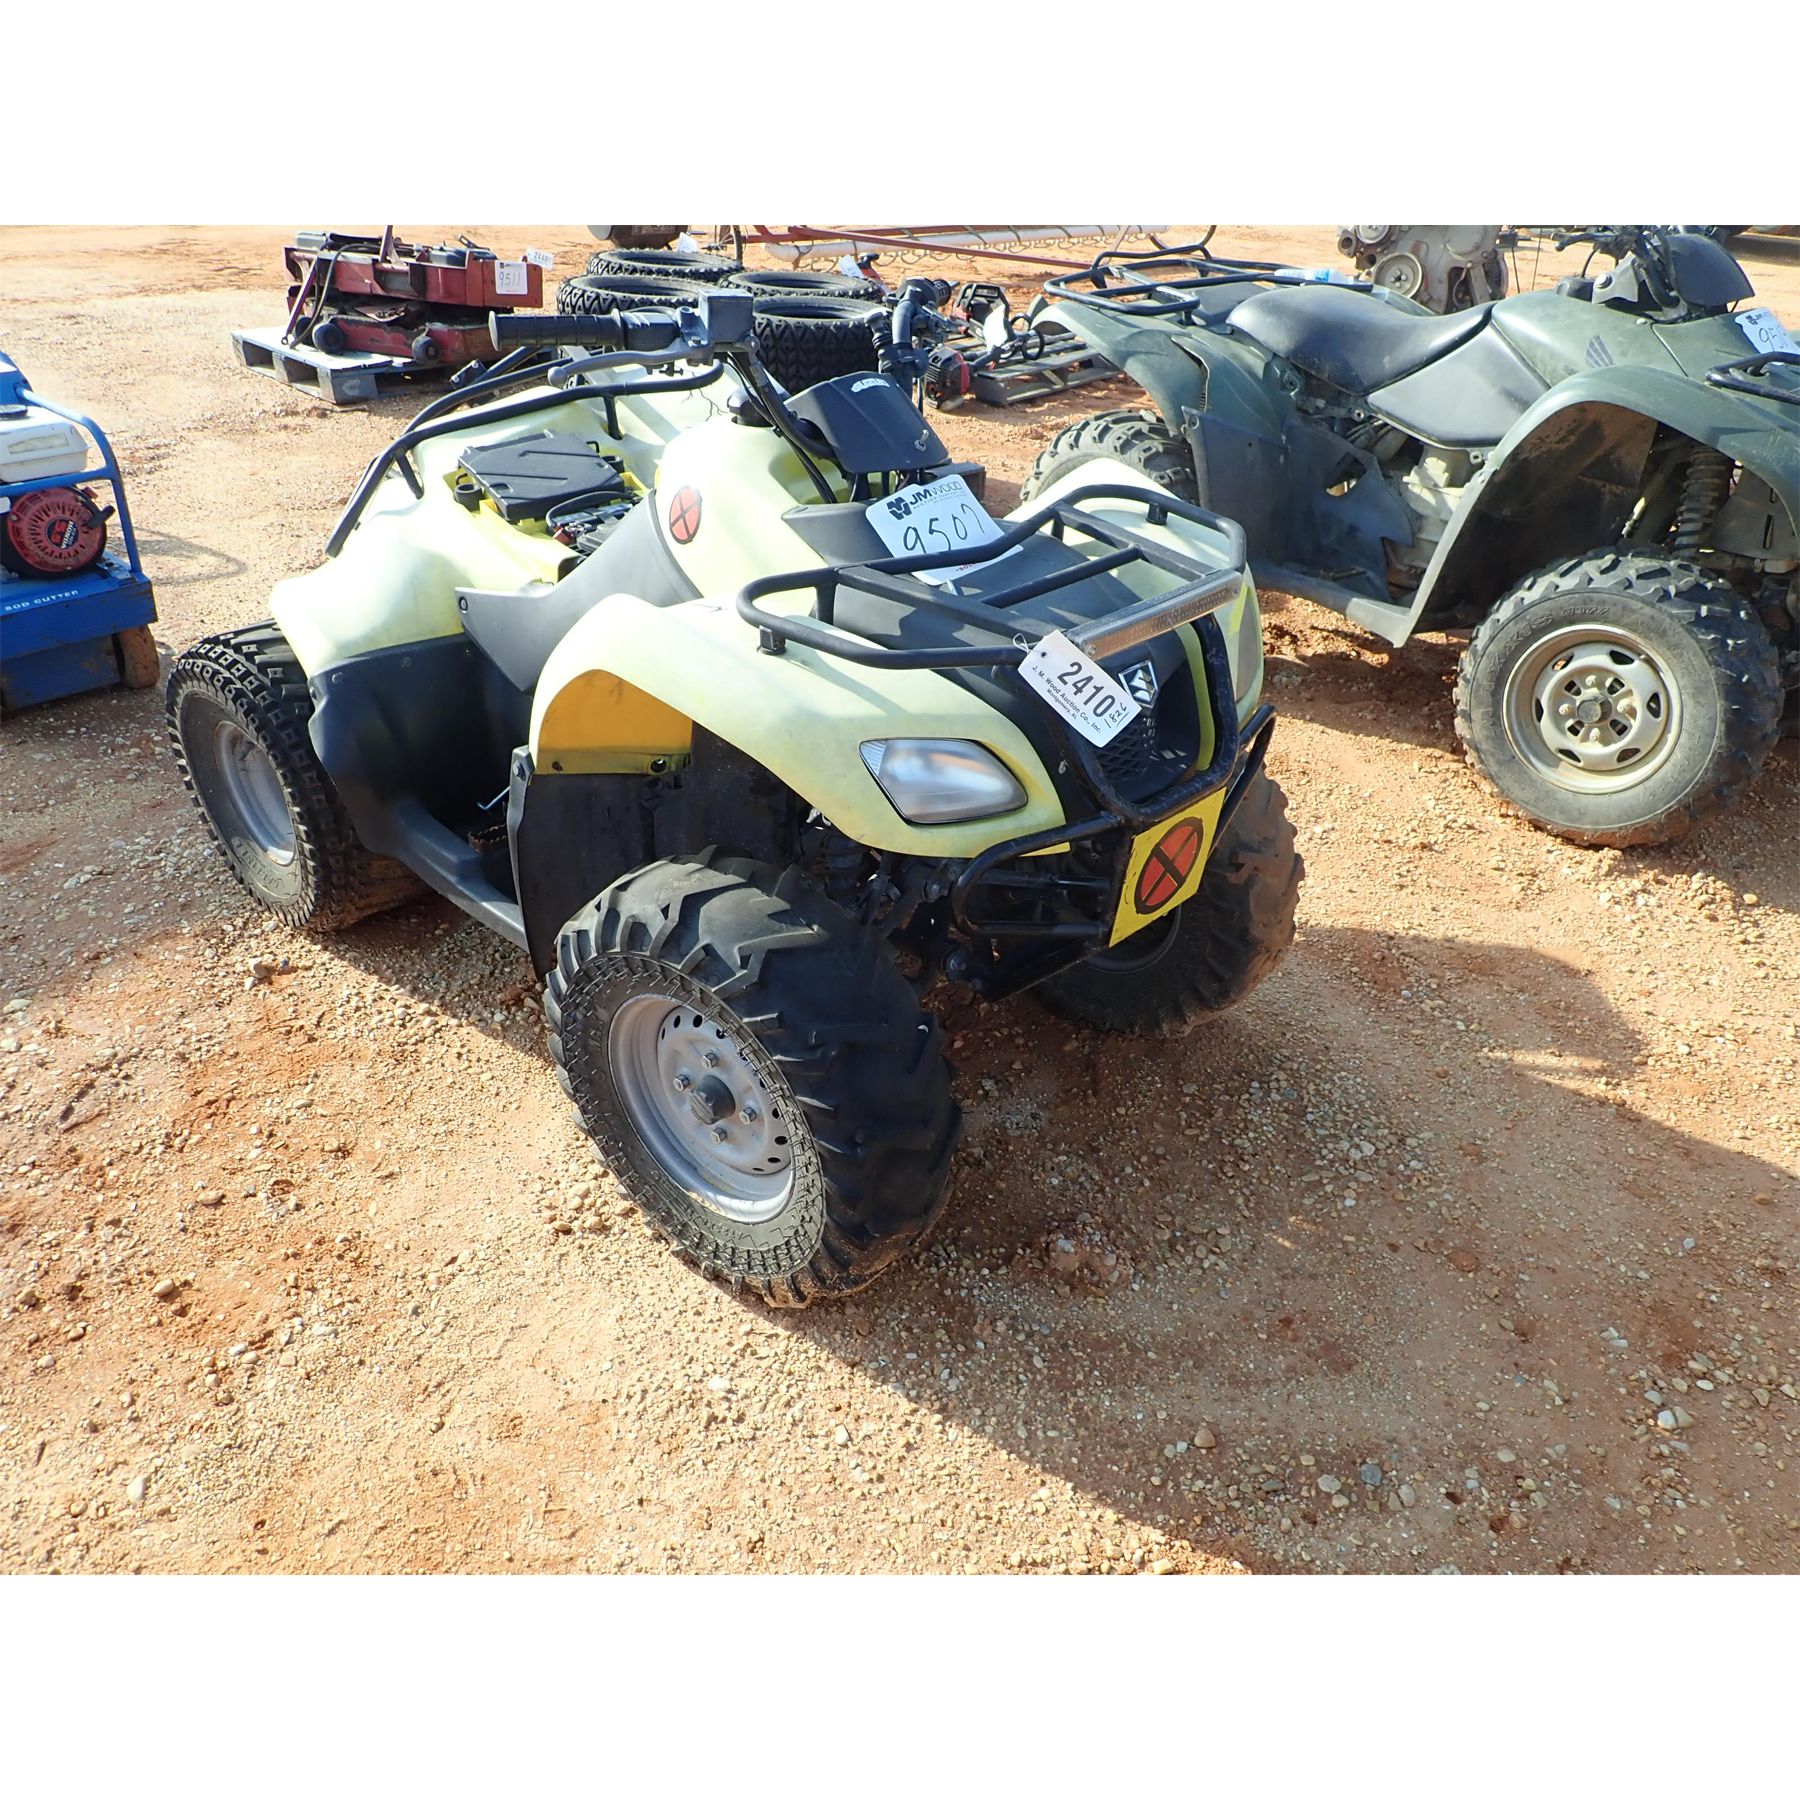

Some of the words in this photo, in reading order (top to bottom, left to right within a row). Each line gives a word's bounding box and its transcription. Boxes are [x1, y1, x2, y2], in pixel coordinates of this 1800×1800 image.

[498, 271, 521, 288] 9511
[61, 520, 74, 549] HONDA
[903, 503, 985, 554] 9507
[4, 601, 30, 611] SOD
[34, 590, 79, 604] CUTTER
[1045, 678, 1061, 694] Wood
[1060, 693, 1081, 713] Auction
[1057, 661, 1116, 718] 2410
